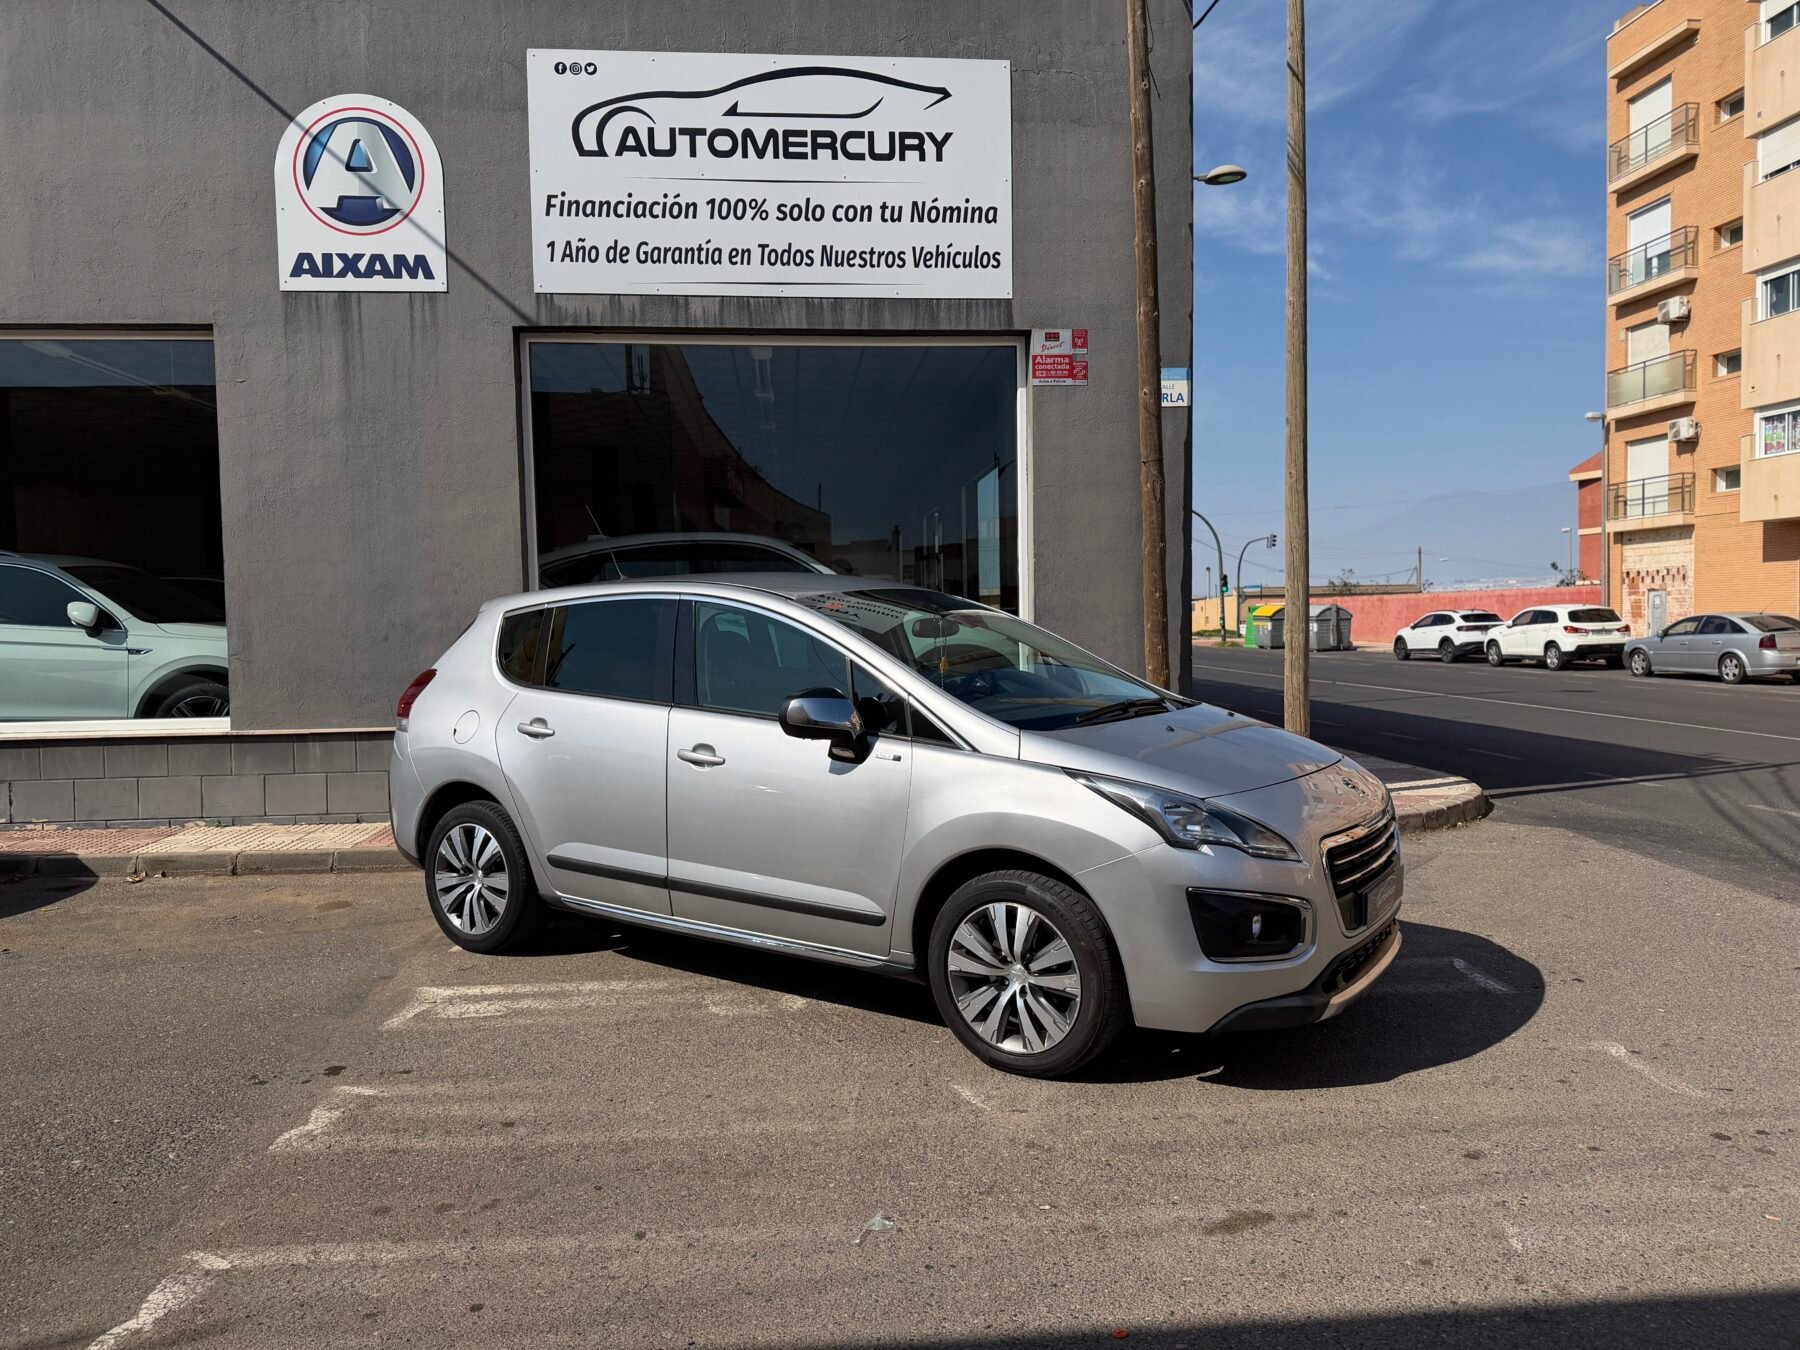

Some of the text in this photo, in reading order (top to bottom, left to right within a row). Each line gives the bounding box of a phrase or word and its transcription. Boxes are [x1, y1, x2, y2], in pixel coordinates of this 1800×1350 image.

[614, 125, 954, 163] AUTOMERCURY
[545, 190, 998, 225] Financiación 100% solo con tu Nómina
[289, 252, 436, 280] AIXAM
[546, 238, 1001, 270] 1 Año de Garantía en Todos Nuestros Vehículos
[1035, 355, 1070, 364] Alarma
[1162, 392, 1185, 402] RLA
